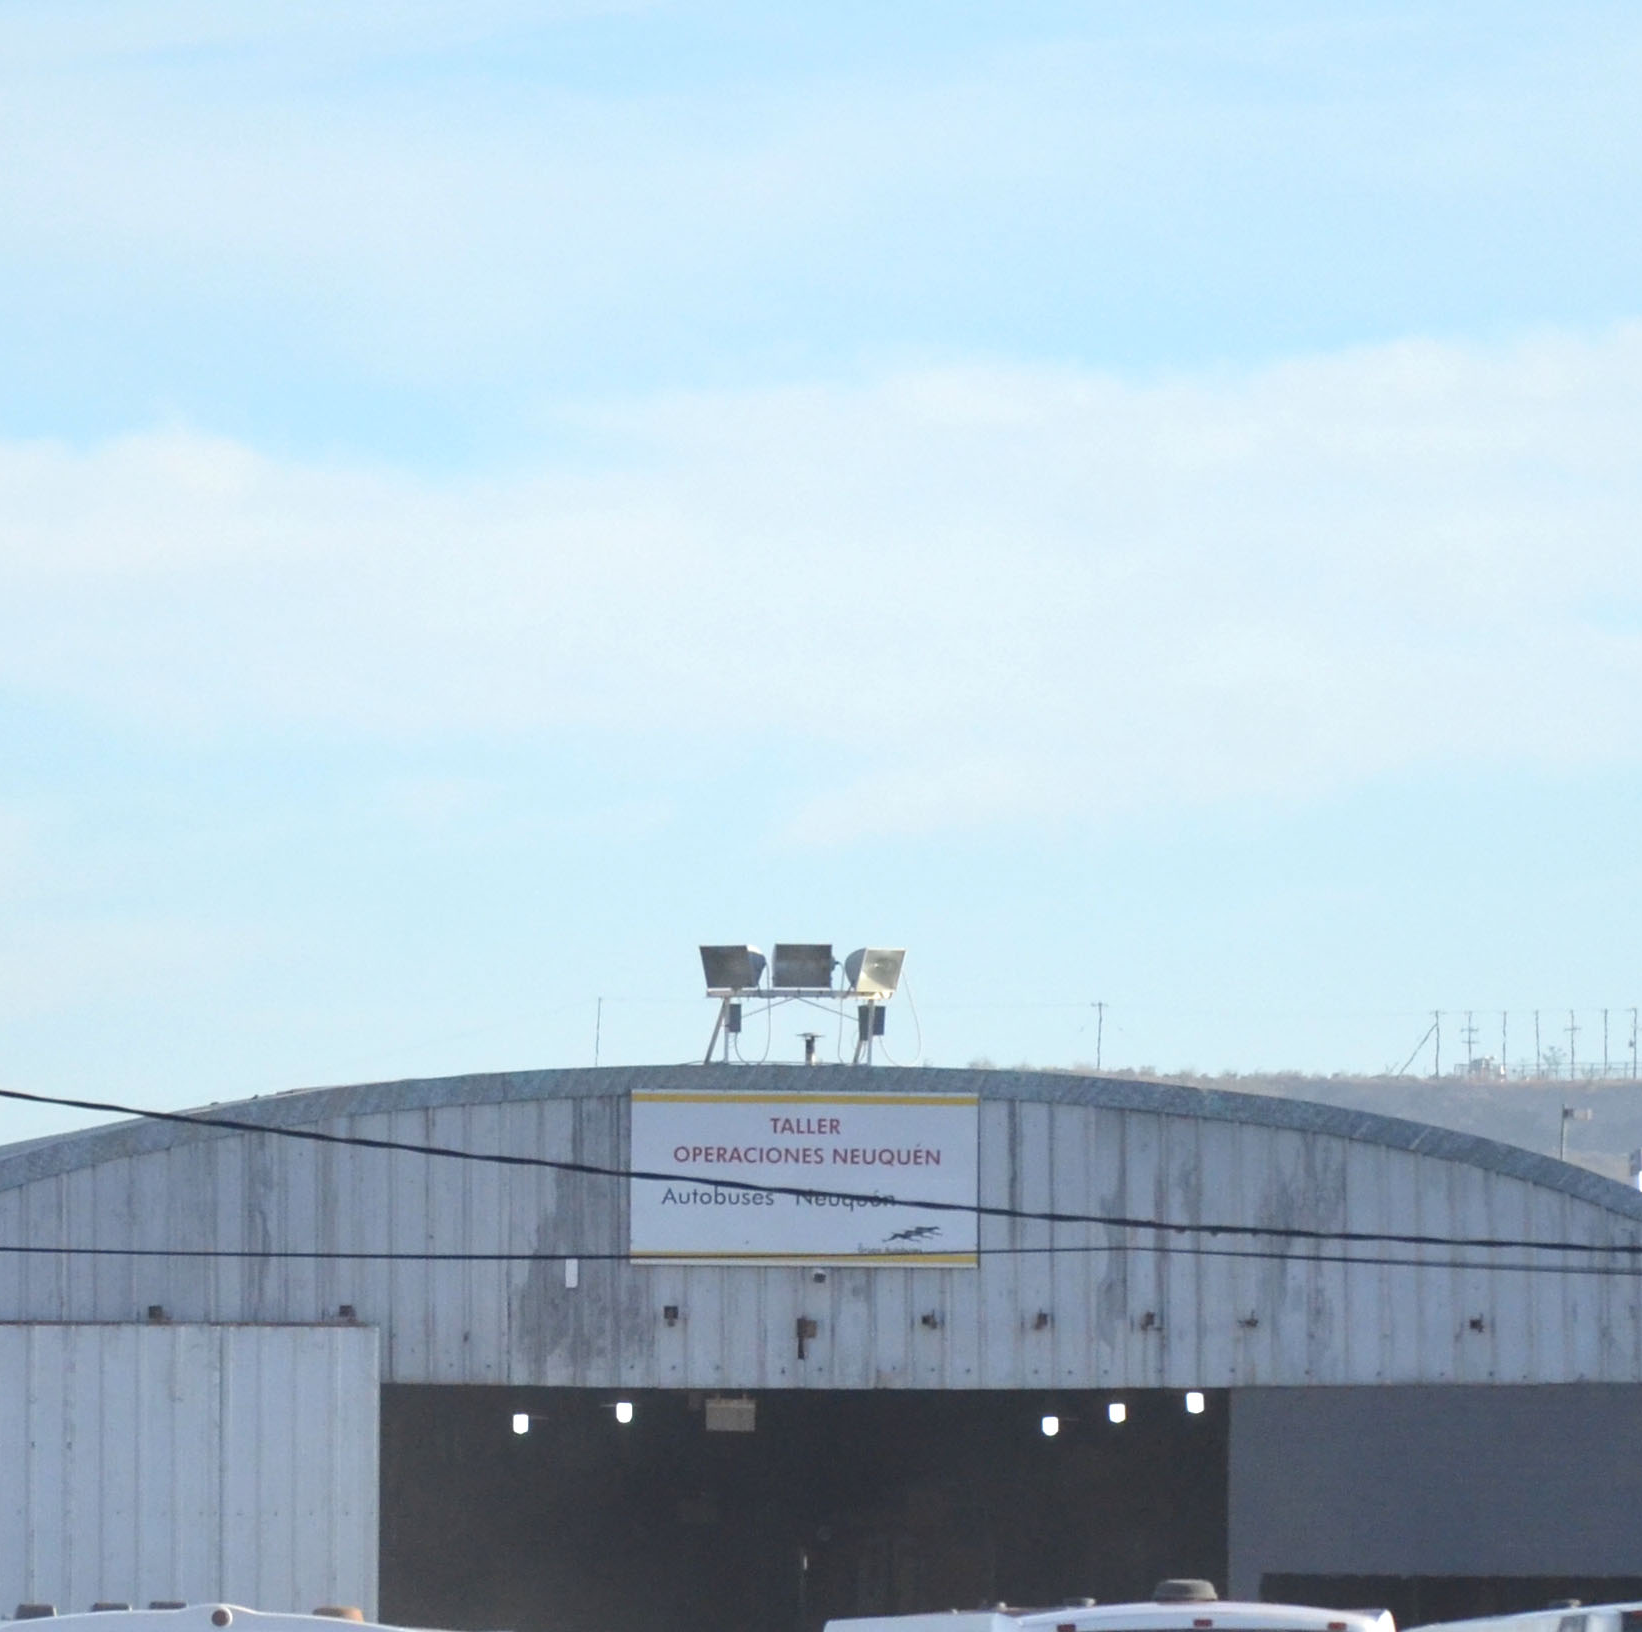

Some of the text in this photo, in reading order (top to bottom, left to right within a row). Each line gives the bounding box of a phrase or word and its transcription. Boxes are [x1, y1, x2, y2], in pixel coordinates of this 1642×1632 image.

[770, 1118, 840, 1134] TALLER
[673, 1144, 941, 1166] OPERACIONES NEUQUÉN
[661, 1186, 775, 1206] Autobuses
